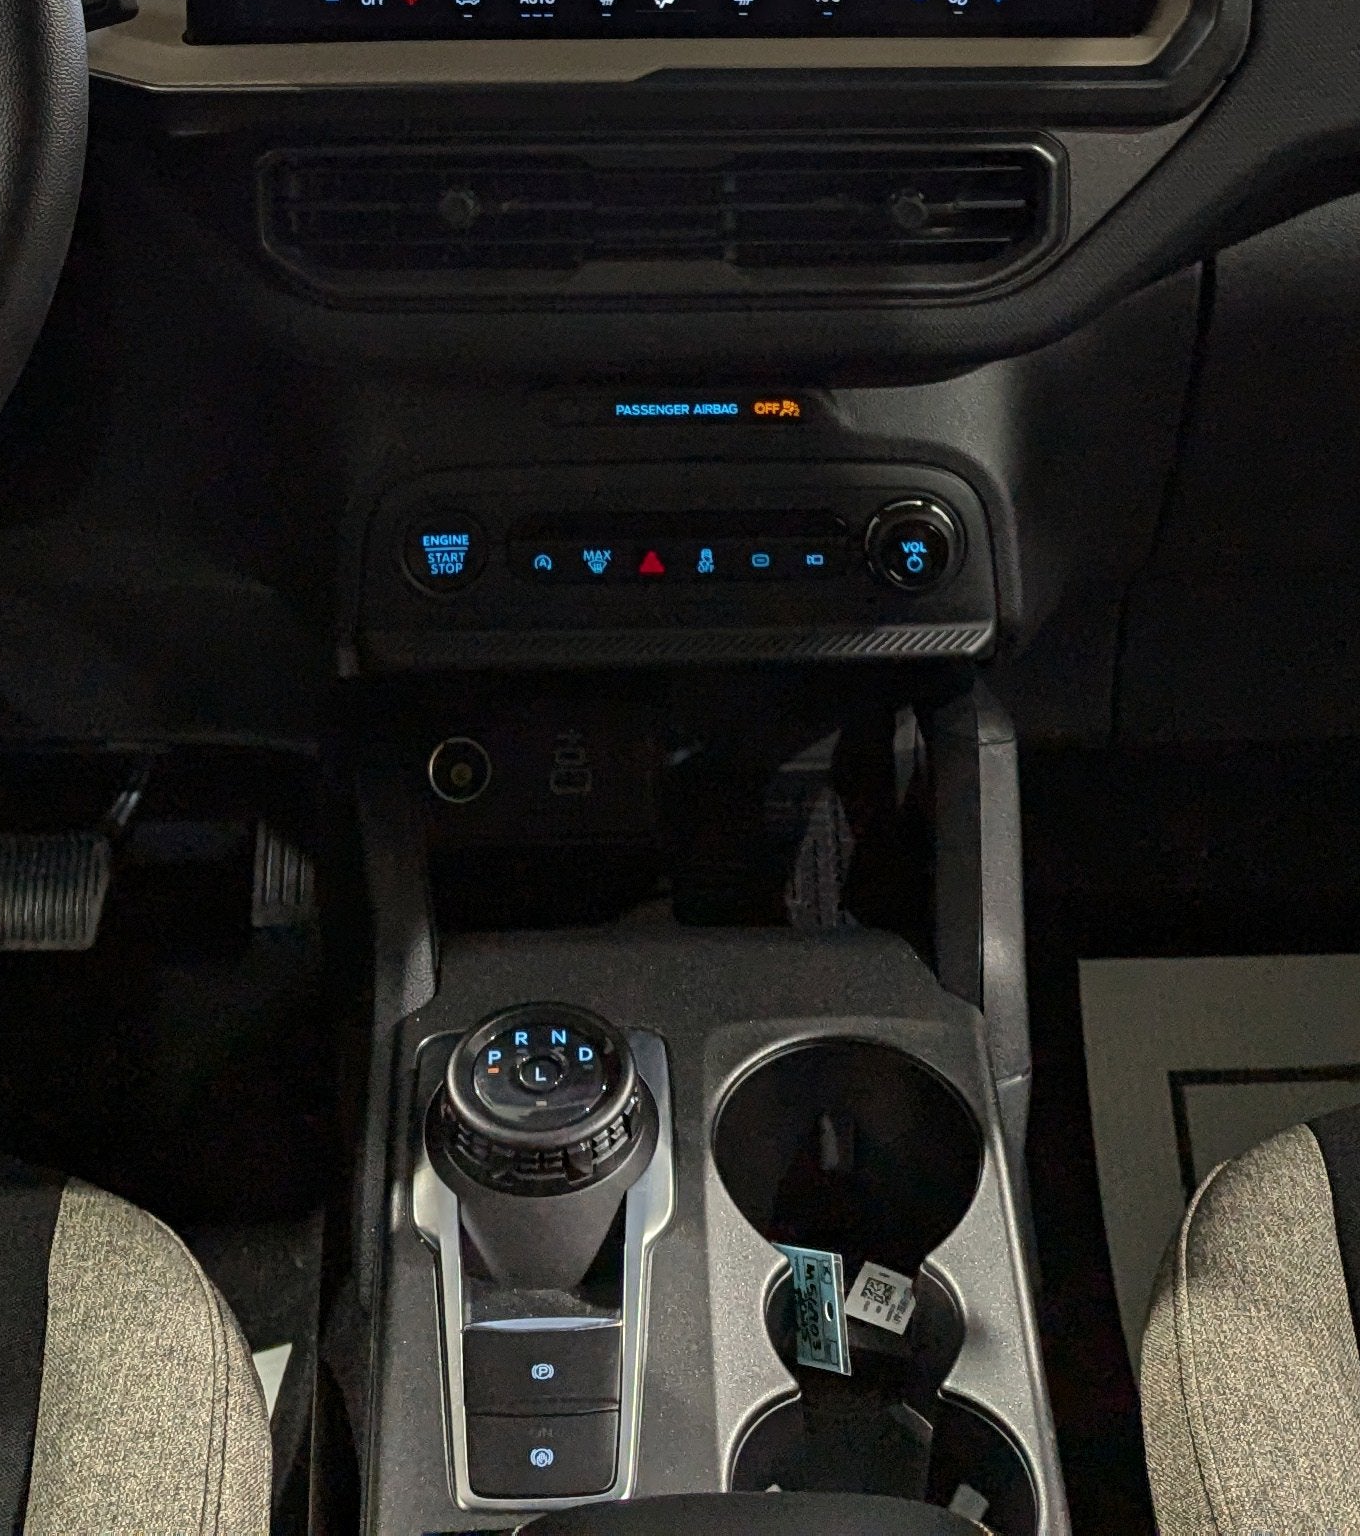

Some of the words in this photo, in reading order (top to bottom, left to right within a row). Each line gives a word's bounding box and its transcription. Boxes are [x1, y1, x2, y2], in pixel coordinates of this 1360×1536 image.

[616, 404, 690, 416] PASSENGER
[693, 403, 739, 415] AIRBAG
[753, 401, 781, 415] OFF
[422, 534, 470, 546] ENGINE
[901, 541, 928, 553] VOL
[427, 552, 466, 564] START
[583, 549, 612, 562] MAX
[430, 564, 463, 575] STOP
[514, 1031, 529, 1046] R
[551, 1029, 567, 1045] N
[488, 1050, 502, 1065] P
[578, 1046, 593, 1062] D
[535, 1066, 547, 1082] L
